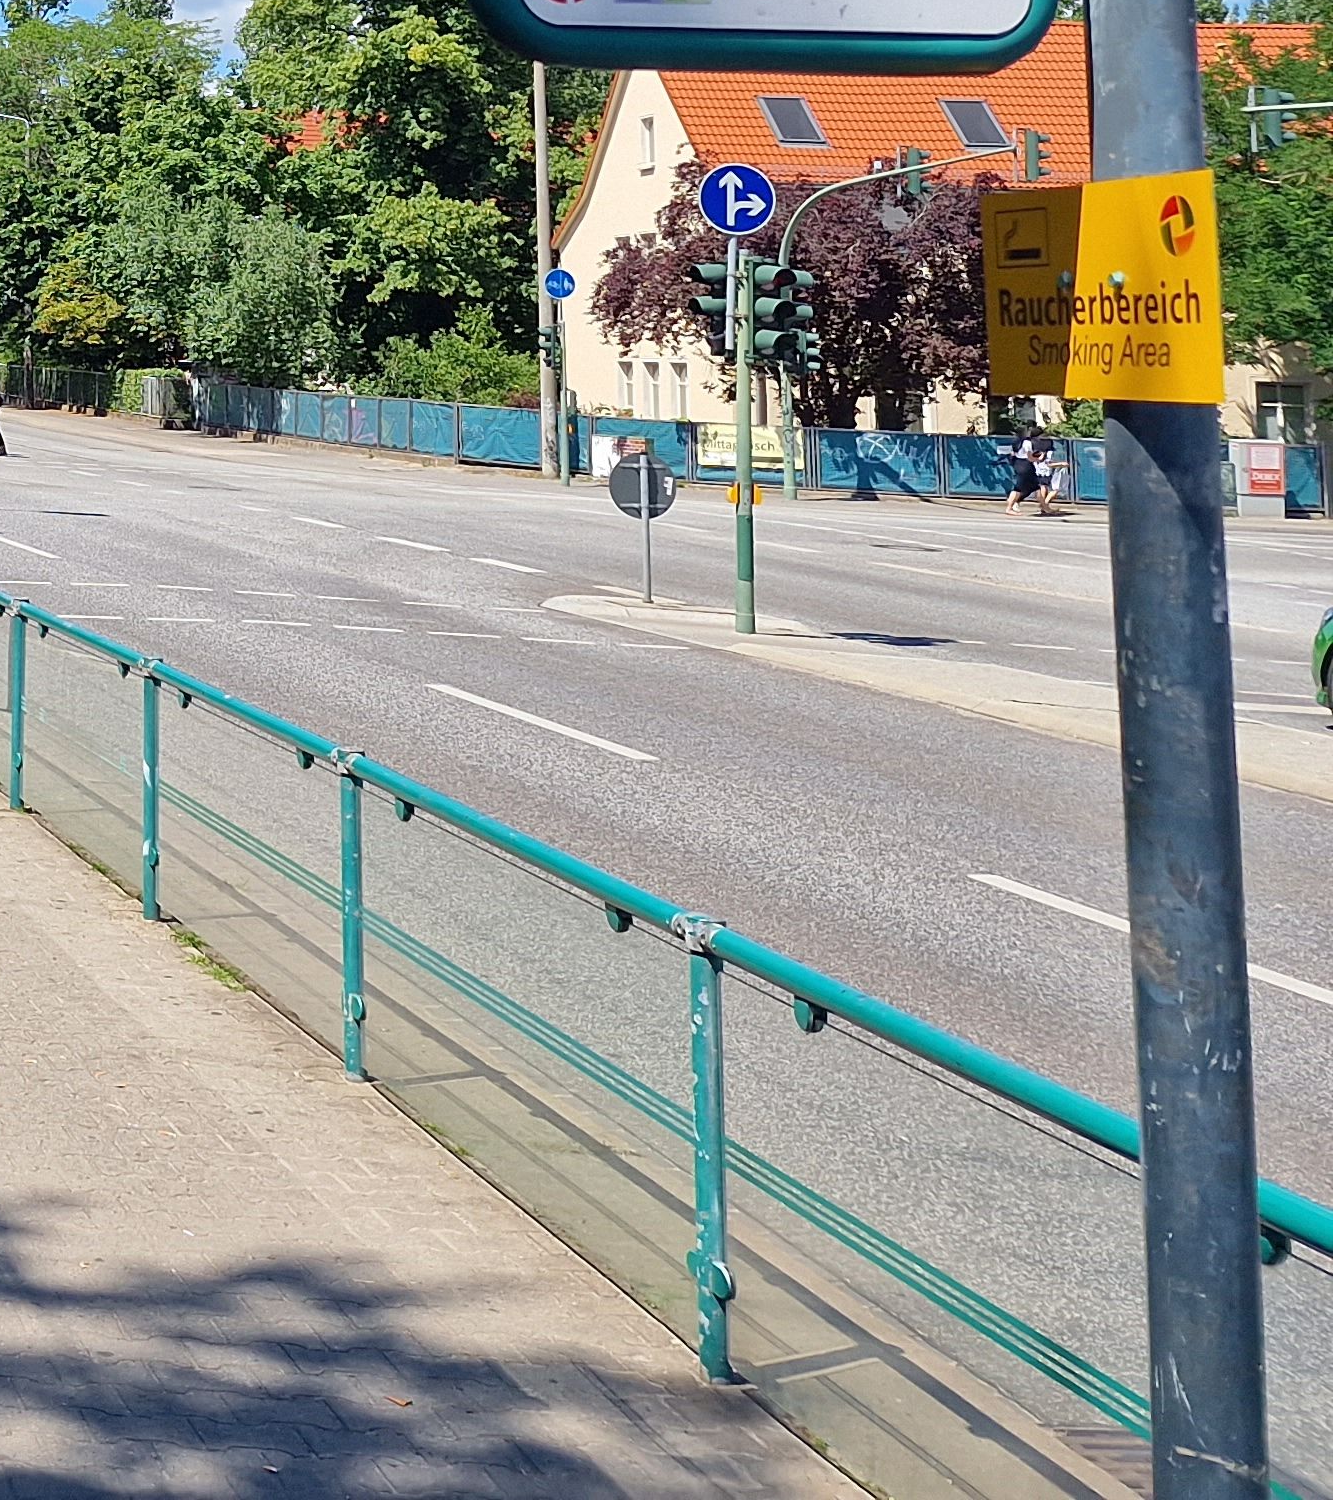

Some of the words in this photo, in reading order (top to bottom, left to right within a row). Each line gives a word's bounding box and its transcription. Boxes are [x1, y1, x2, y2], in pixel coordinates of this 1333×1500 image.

[998, 279, 1201, 328] Raucherbereich
[1028, 334, 1114, 375] Smoking
[1119, 336, 1171, 368] Area
